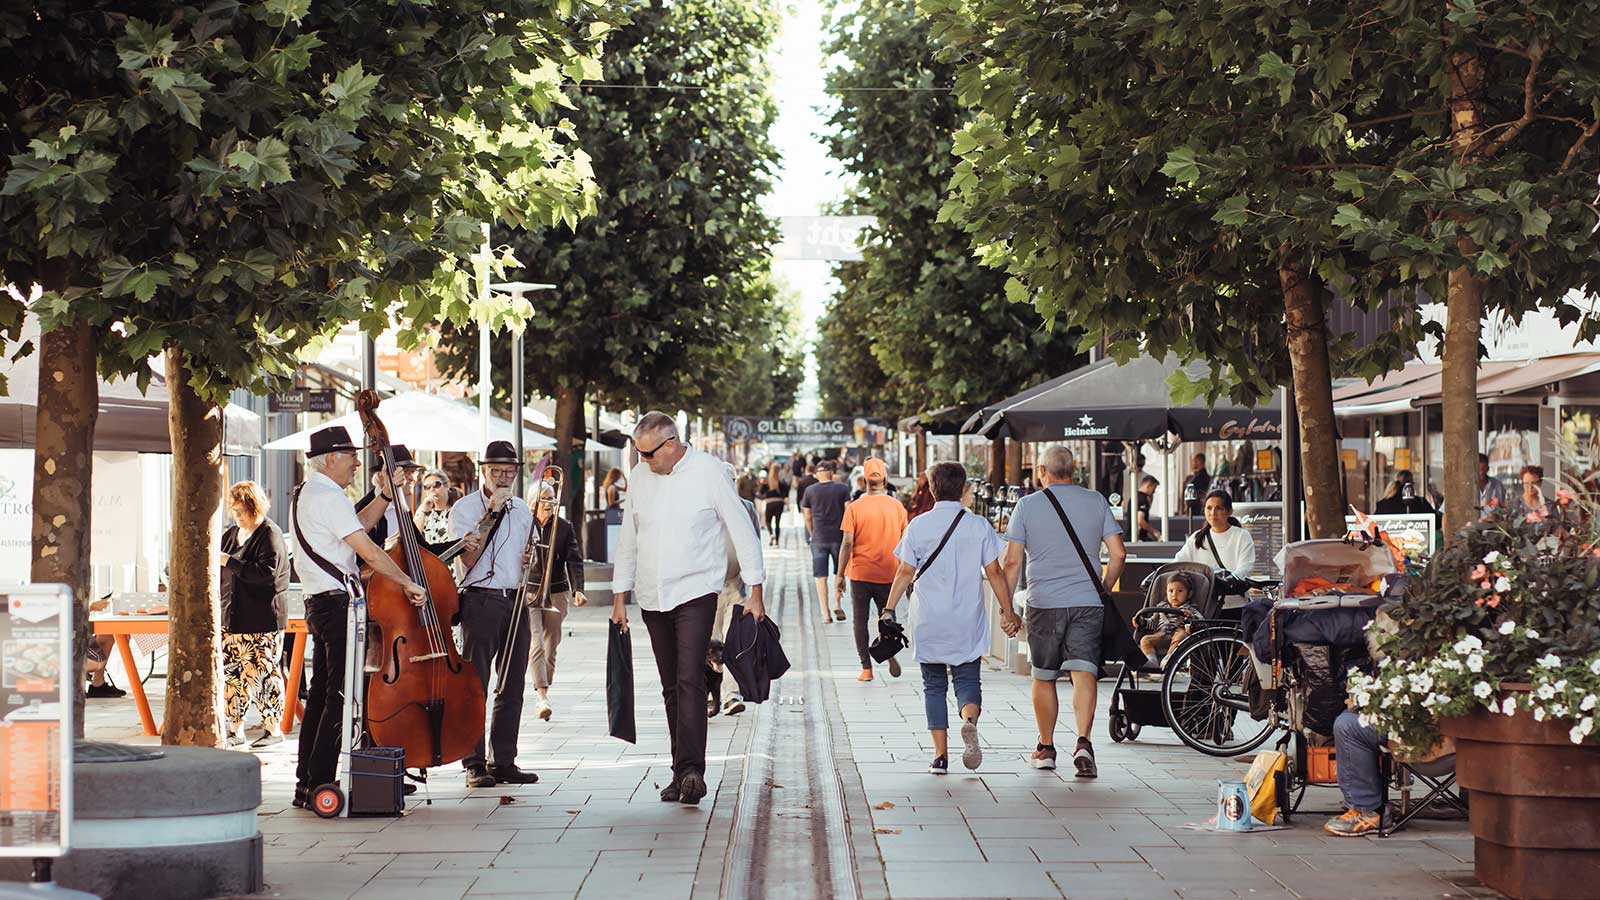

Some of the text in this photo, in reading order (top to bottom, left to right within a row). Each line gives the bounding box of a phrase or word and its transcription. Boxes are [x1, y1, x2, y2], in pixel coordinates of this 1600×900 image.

[757, 420, 844, 433] ØLLETS DAG
[1064, 425, 1109, 437] Heineken
